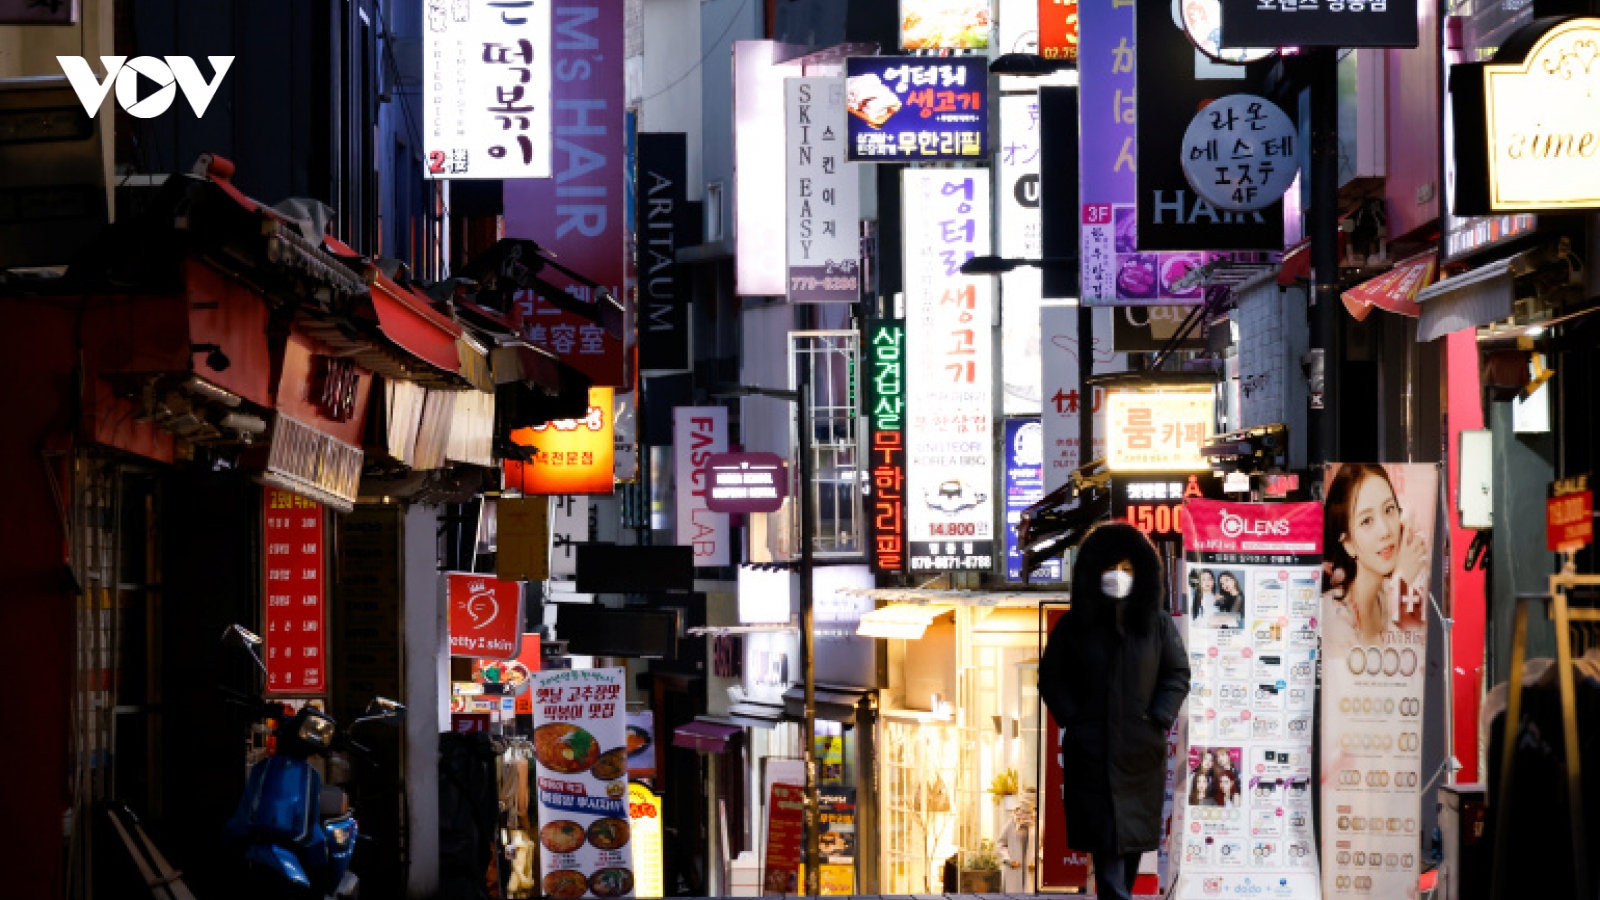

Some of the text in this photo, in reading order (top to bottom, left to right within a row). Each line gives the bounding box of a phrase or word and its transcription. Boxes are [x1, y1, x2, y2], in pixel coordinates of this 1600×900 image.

[556, 99, 607, 239] HAIR
[799, 83, 812, 260] SKIN EASY
[1232, 188, 1258, 203] 4F
[648, 171, 674, 331] ARITAUM
[873, 327, 905, 569] 삼겹살 무한리필
[1122, 408, 1156, 449] 룸
